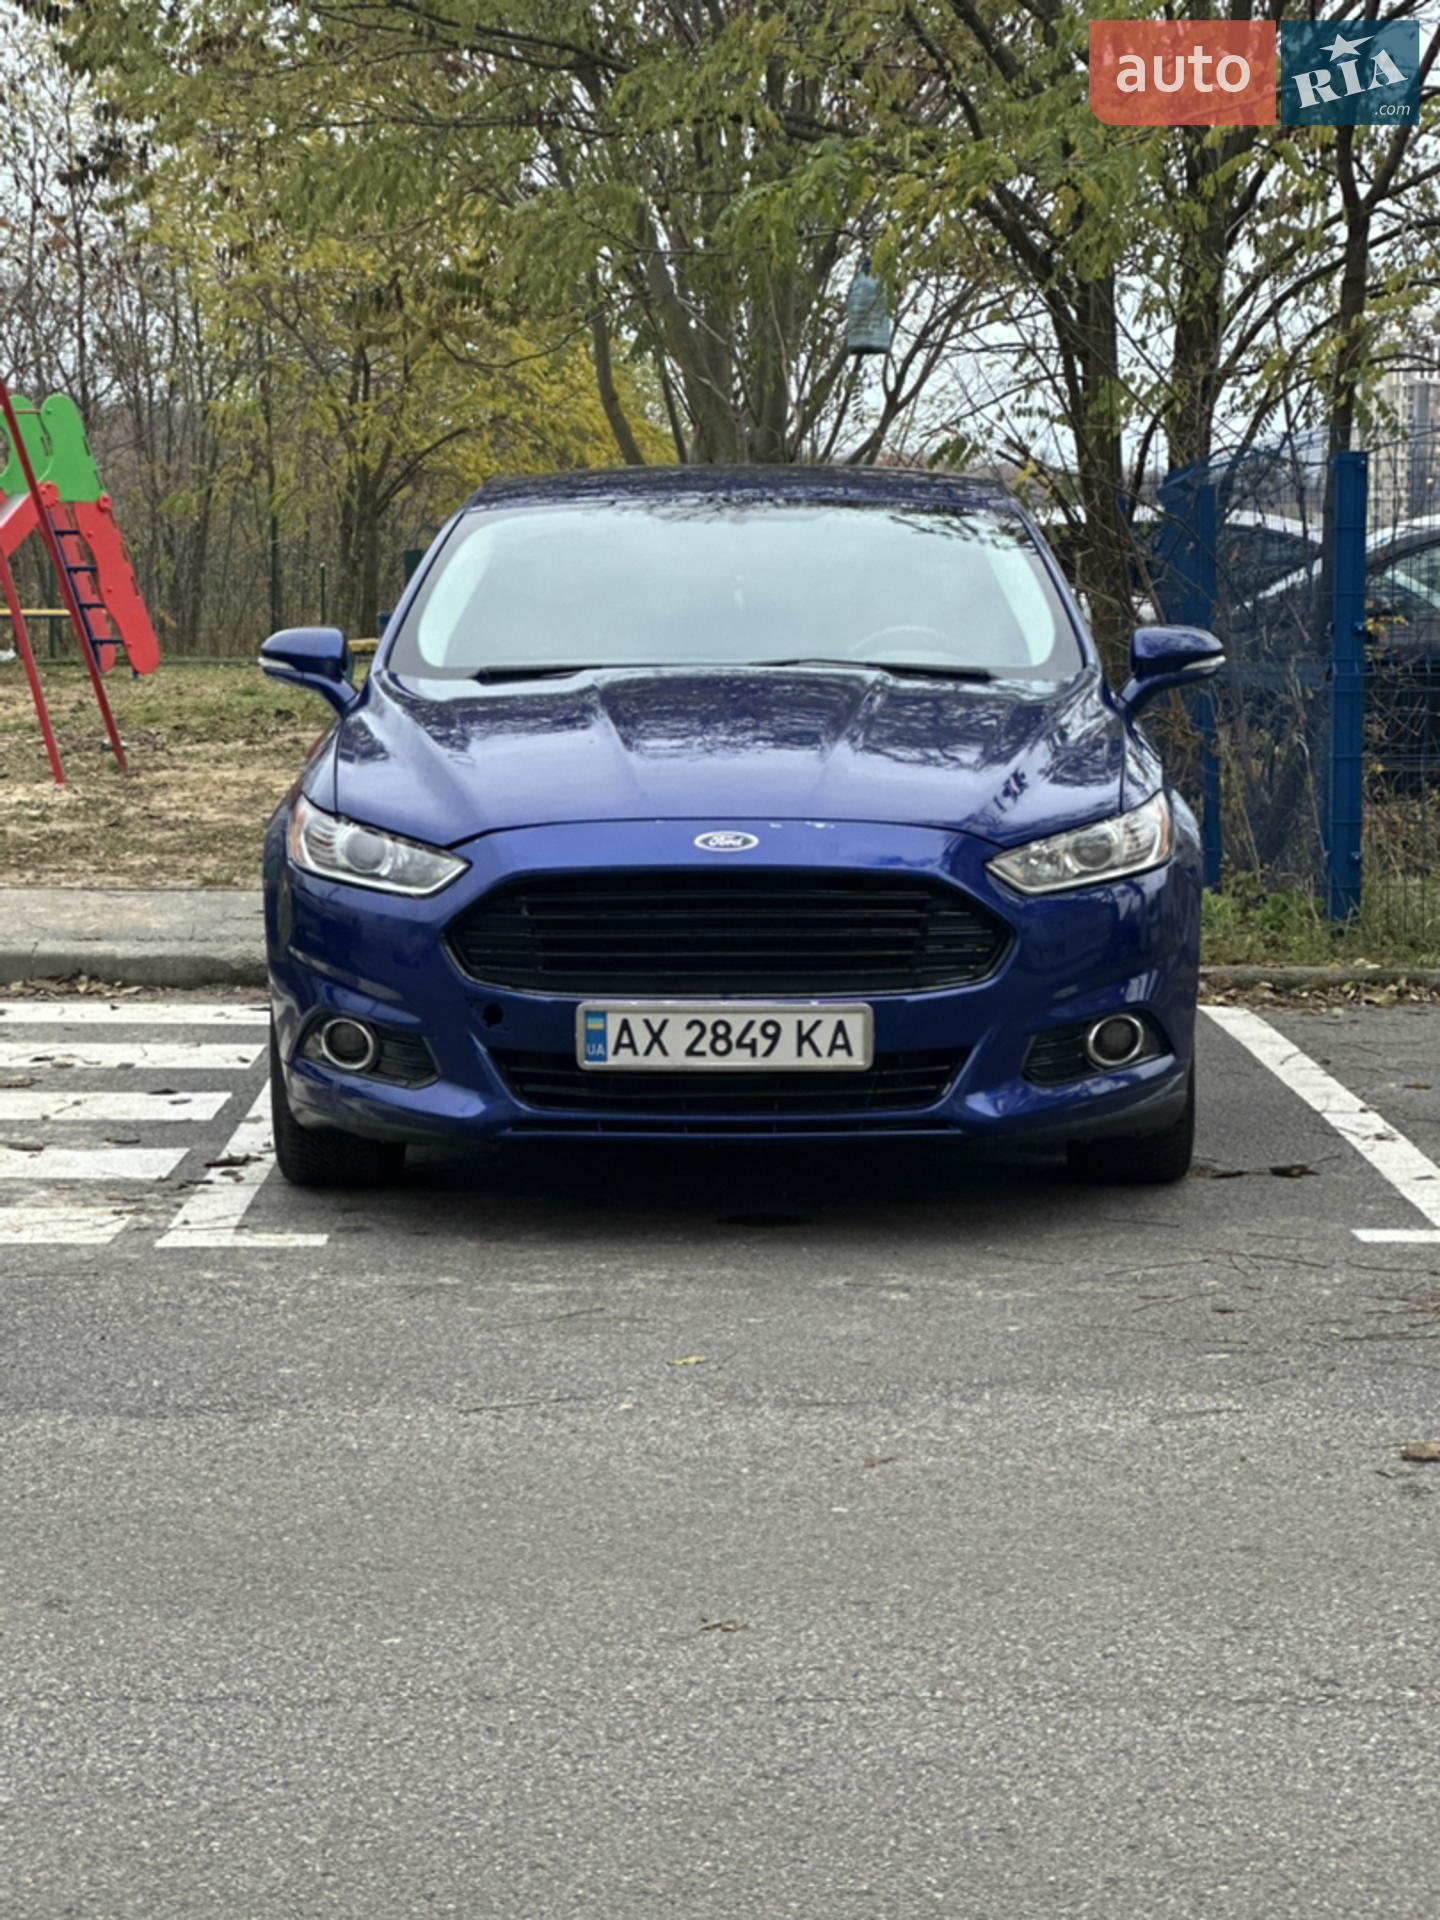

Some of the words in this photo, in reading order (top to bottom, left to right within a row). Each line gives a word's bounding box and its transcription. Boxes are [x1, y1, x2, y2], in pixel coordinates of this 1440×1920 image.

[586, 1043, 605, 1056] UA
[612, 1018, 669, 1057] AX
[684, 1018, 782, 1058] 2849
[796, 1019, 854, 1058] KA
